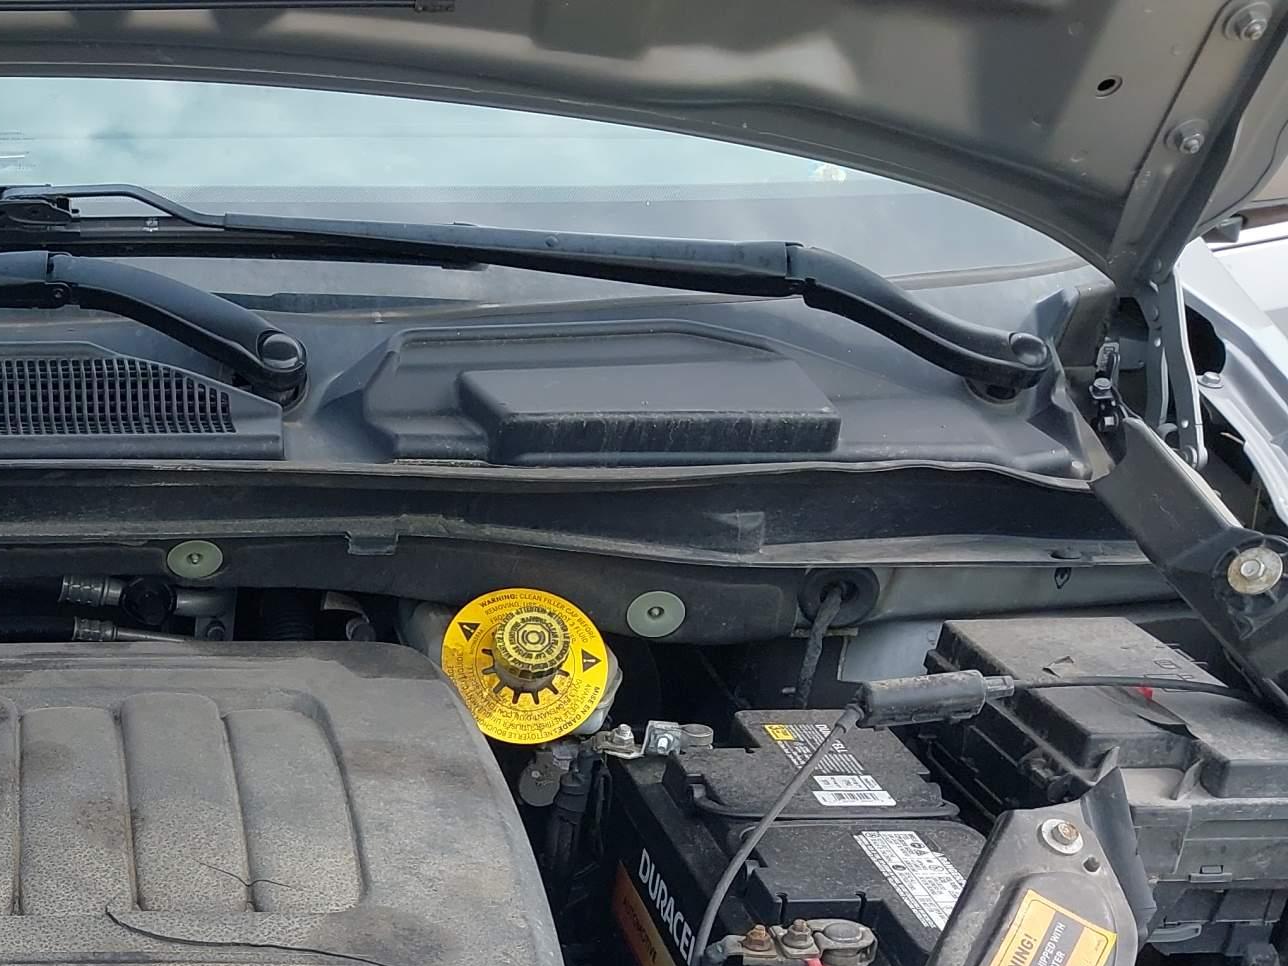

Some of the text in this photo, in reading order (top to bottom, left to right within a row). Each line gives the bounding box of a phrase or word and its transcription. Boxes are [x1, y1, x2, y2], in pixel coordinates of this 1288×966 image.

[479, 593, 518, 609] WARNING:
[589, 686, 601, 705] MISE
[580, 704, 591, 715] EN
[1050, 921, 1067, 945] WITH
